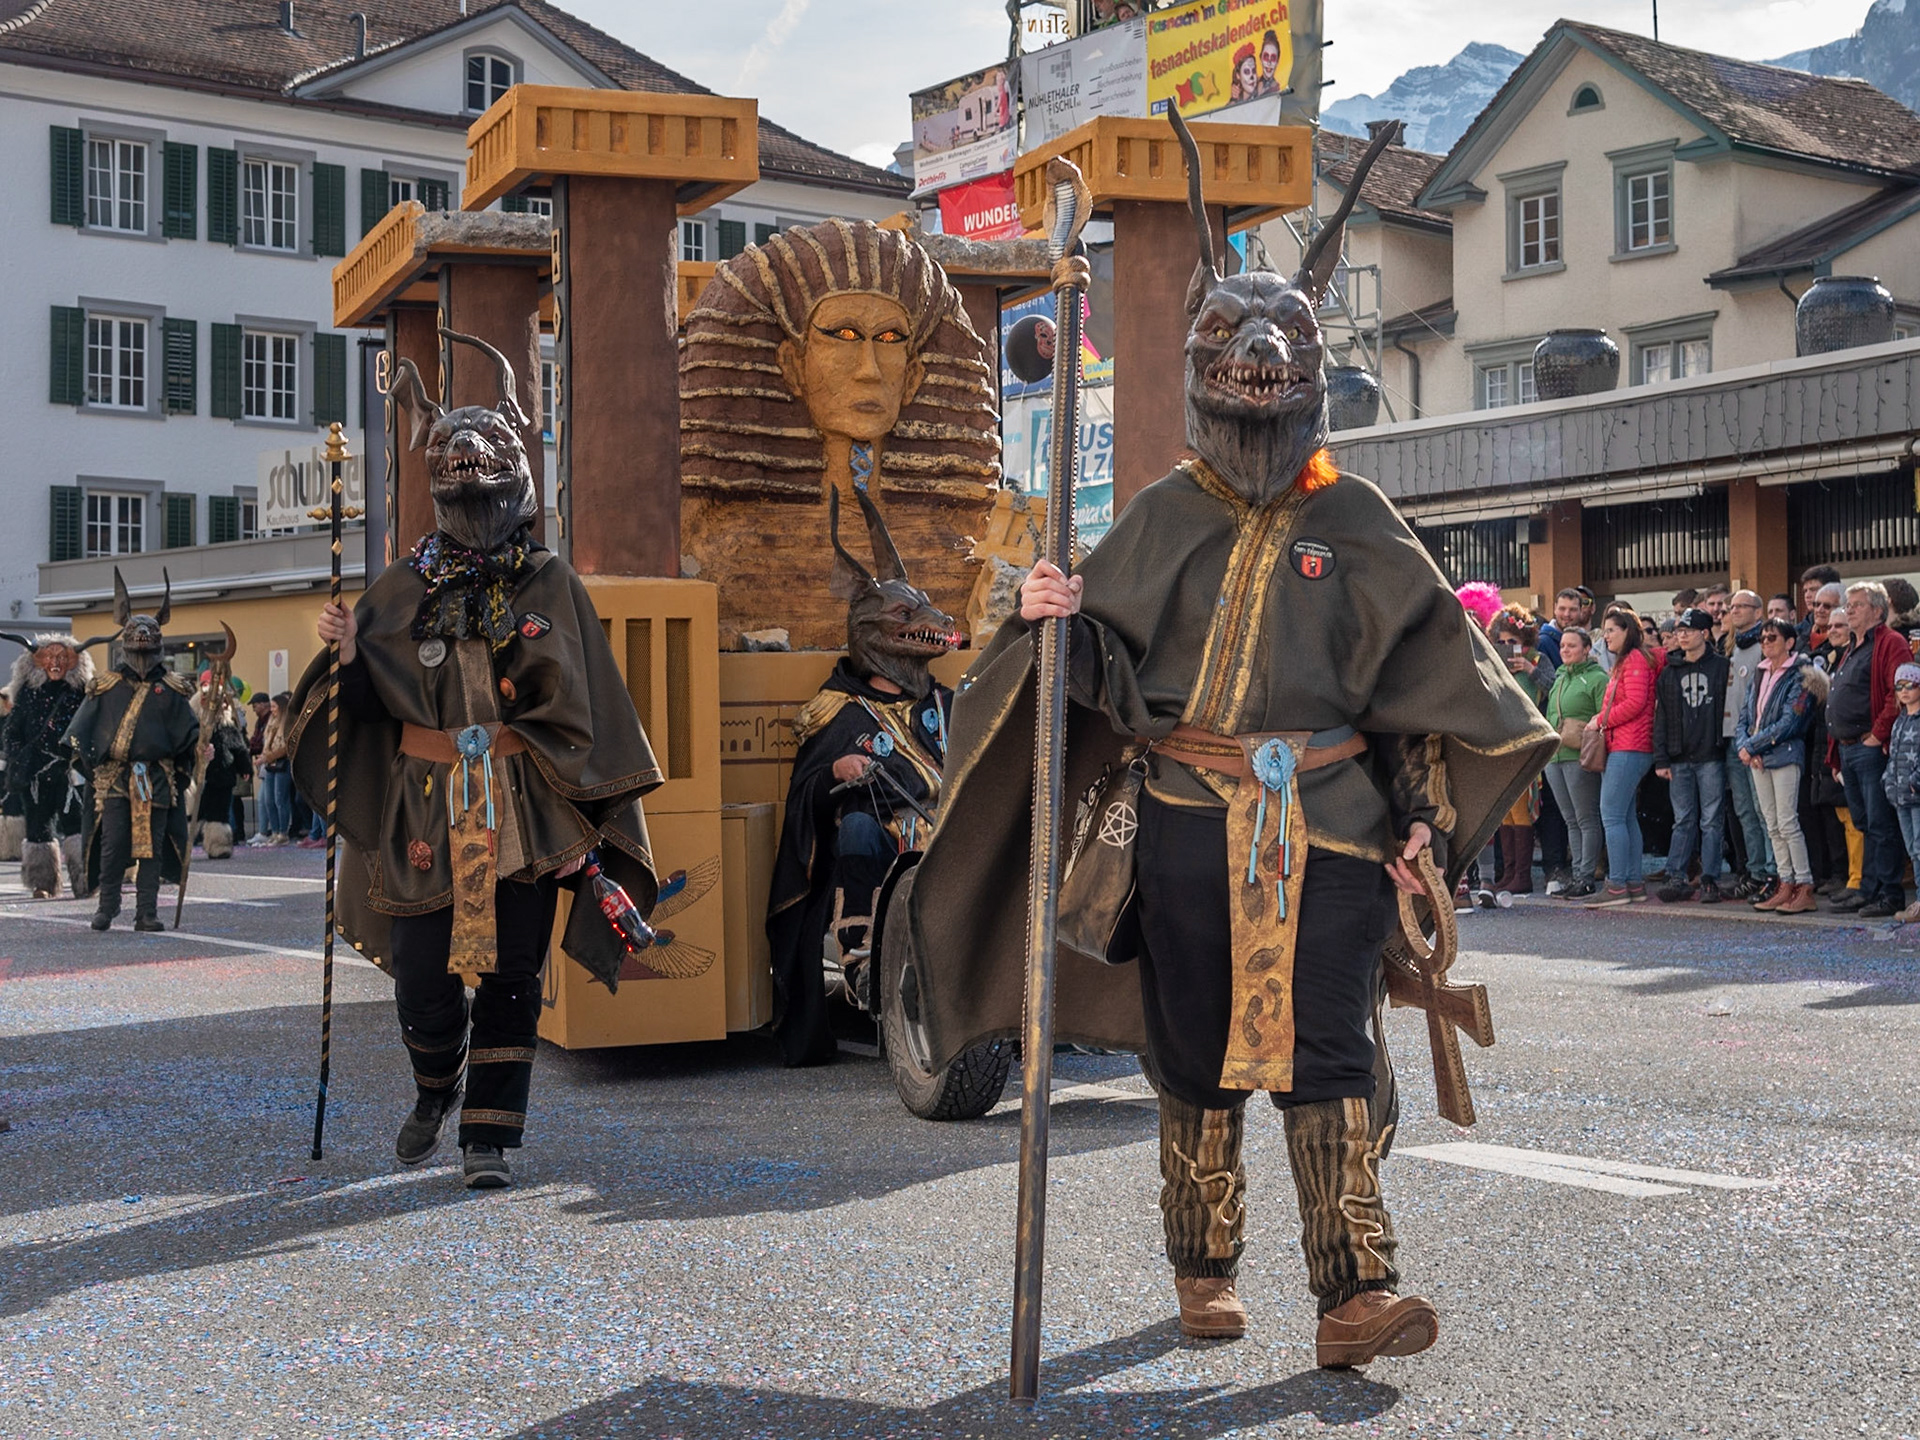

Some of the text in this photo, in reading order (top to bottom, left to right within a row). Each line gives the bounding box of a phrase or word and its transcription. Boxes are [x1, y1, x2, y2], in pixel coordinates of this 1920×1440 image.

[1148, 9, 1199, 35] Fasnacht
[1201, 4, 1215, 20] im
[1150, 2, 1288, 79] fasnachtskalender.ch
[1028, 83, 1080, 109] MÜHLETHALER
[1048, 97, 1076, 116] FISCHLI
[266, 513, 300, 527] Kaufhaus
